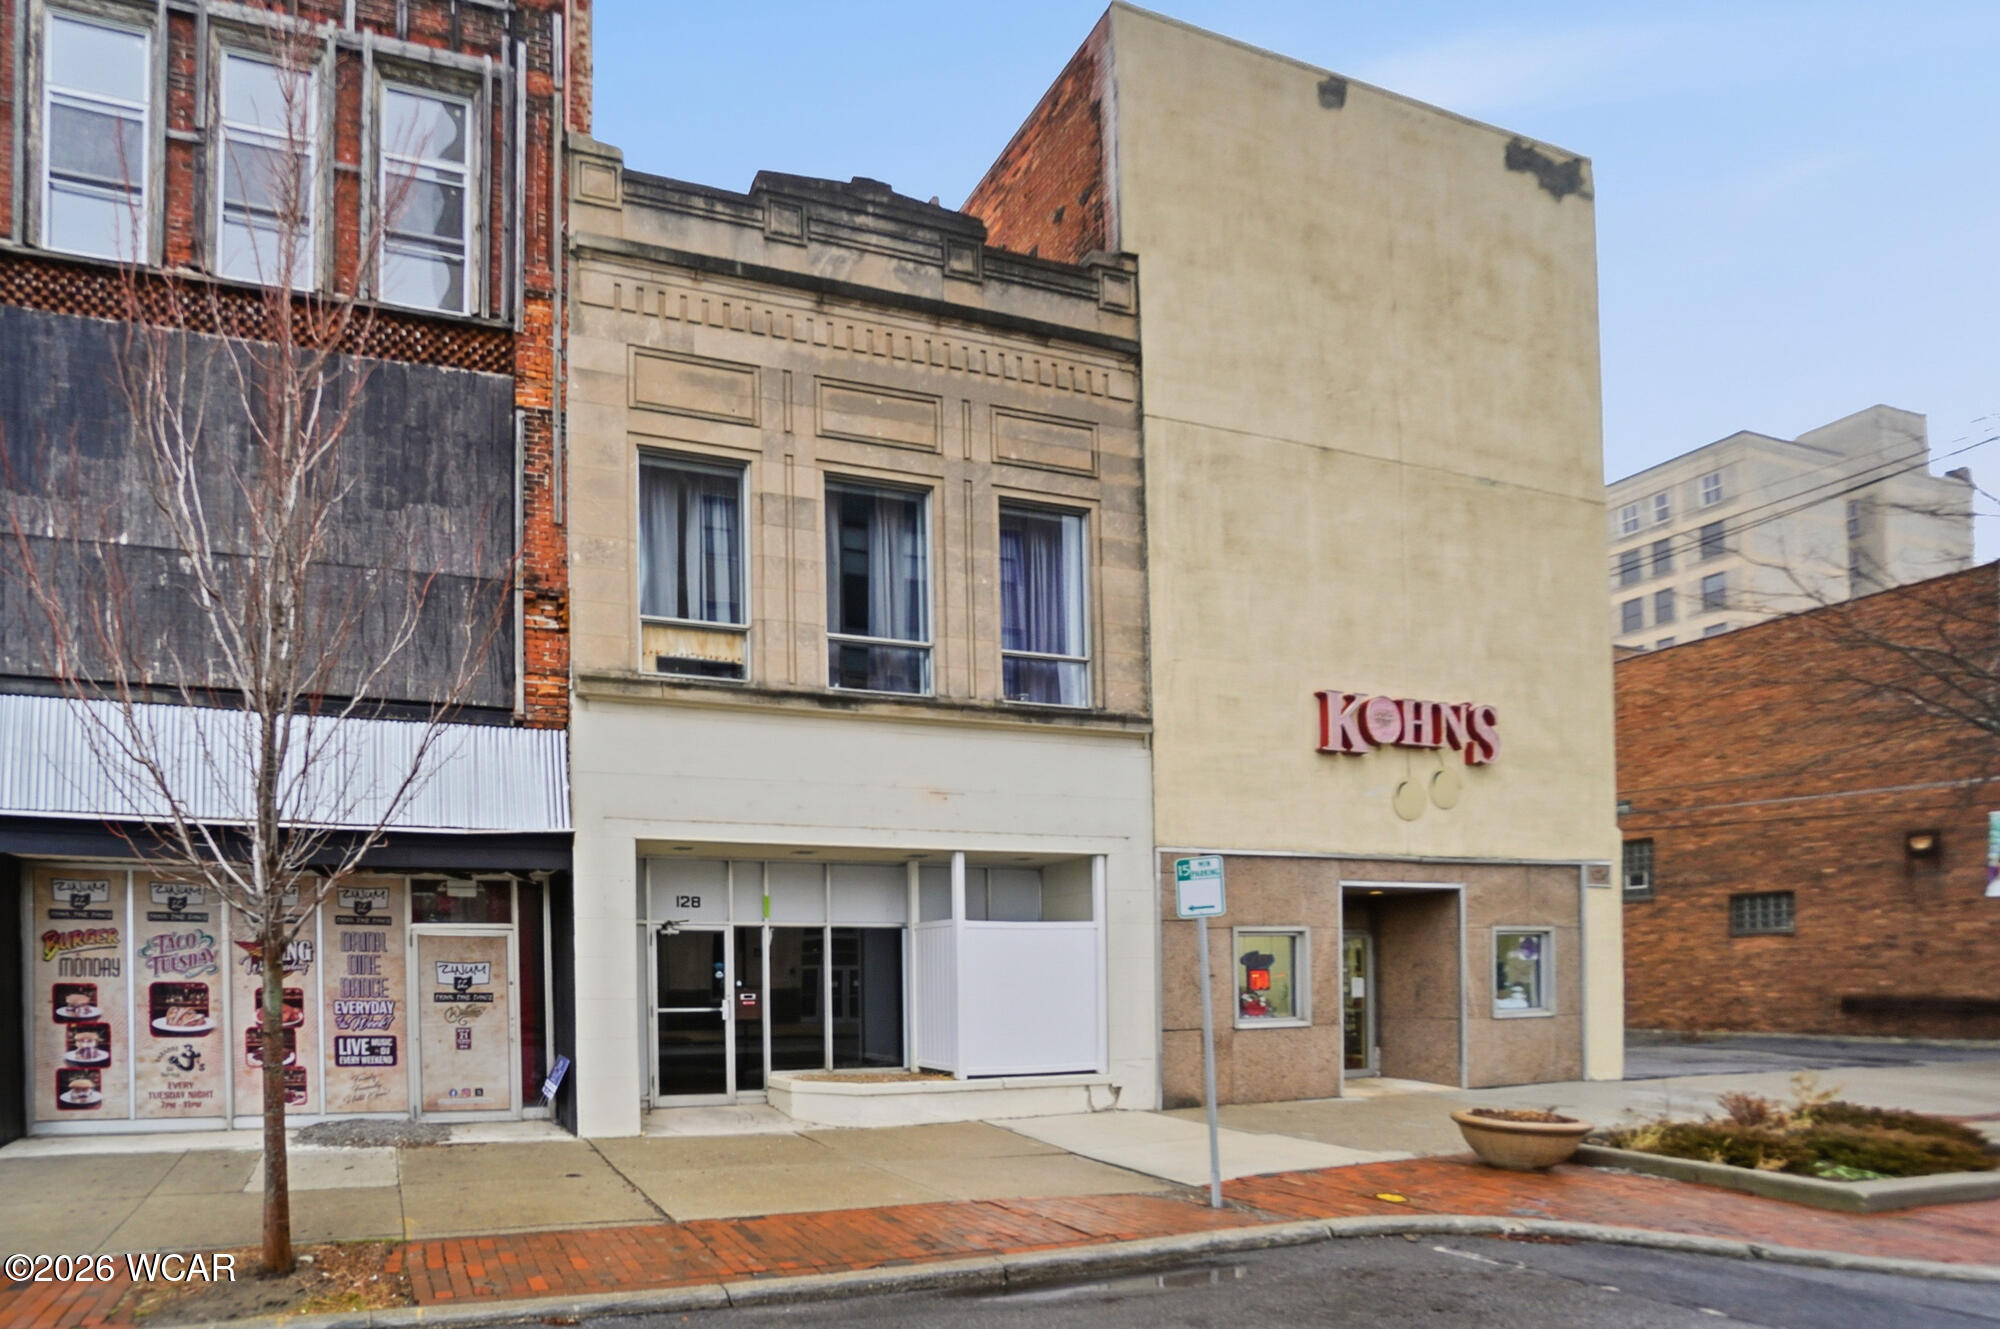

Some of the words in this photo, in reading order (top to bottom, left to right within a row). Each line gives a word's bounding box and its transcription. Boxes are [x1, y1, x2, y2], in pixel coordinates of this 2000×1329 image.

[1178, 865, 1191, 876] 15
[676, 896, 701, 908] 128
[42, 928, 120, 961] BURGER
[150, 932, 198, 954] TACO
[146, 949, 216, 977] TUESDAY
[334, 1000, 394, 1015] EVERYDAY
[338, 1038, 370, 1056] LIVE
[339, 1056, 360, 1065] EVERY
[361, 1056, 394, 1065] WEEKEND
